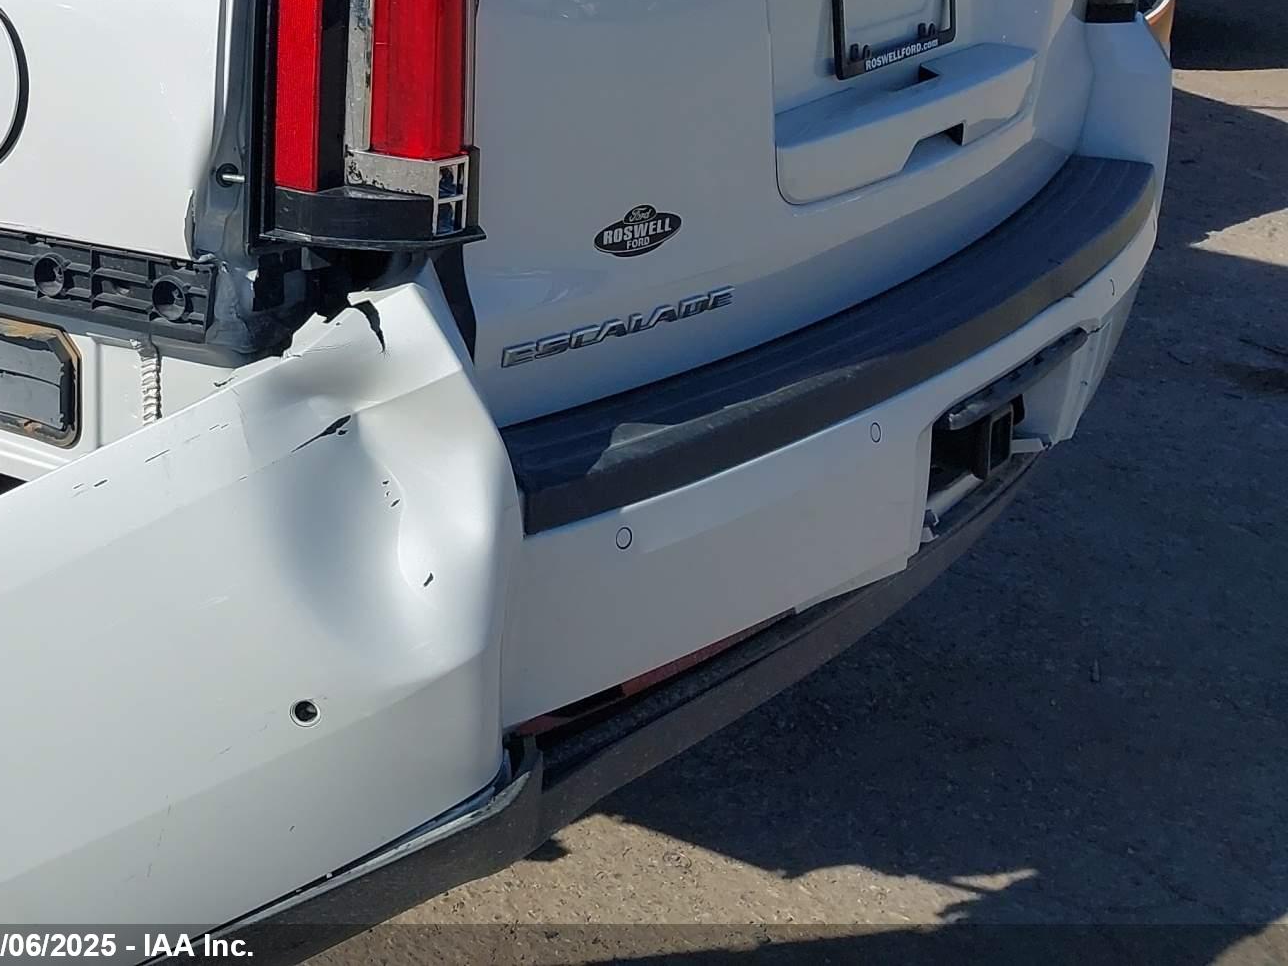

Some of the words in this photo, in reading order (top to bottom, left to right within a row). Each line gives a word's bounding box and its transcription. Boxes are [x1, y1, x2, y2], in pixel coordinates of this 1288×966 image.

[864, 38, 939, 71] ROSWELLFORD.com
[628, 207, 653, 222] Ford
[602, 217, 672, 245] ROSWELL
[626, 236, 650, 250] FORD
[500, 285, 736, 369] ESCALADE
